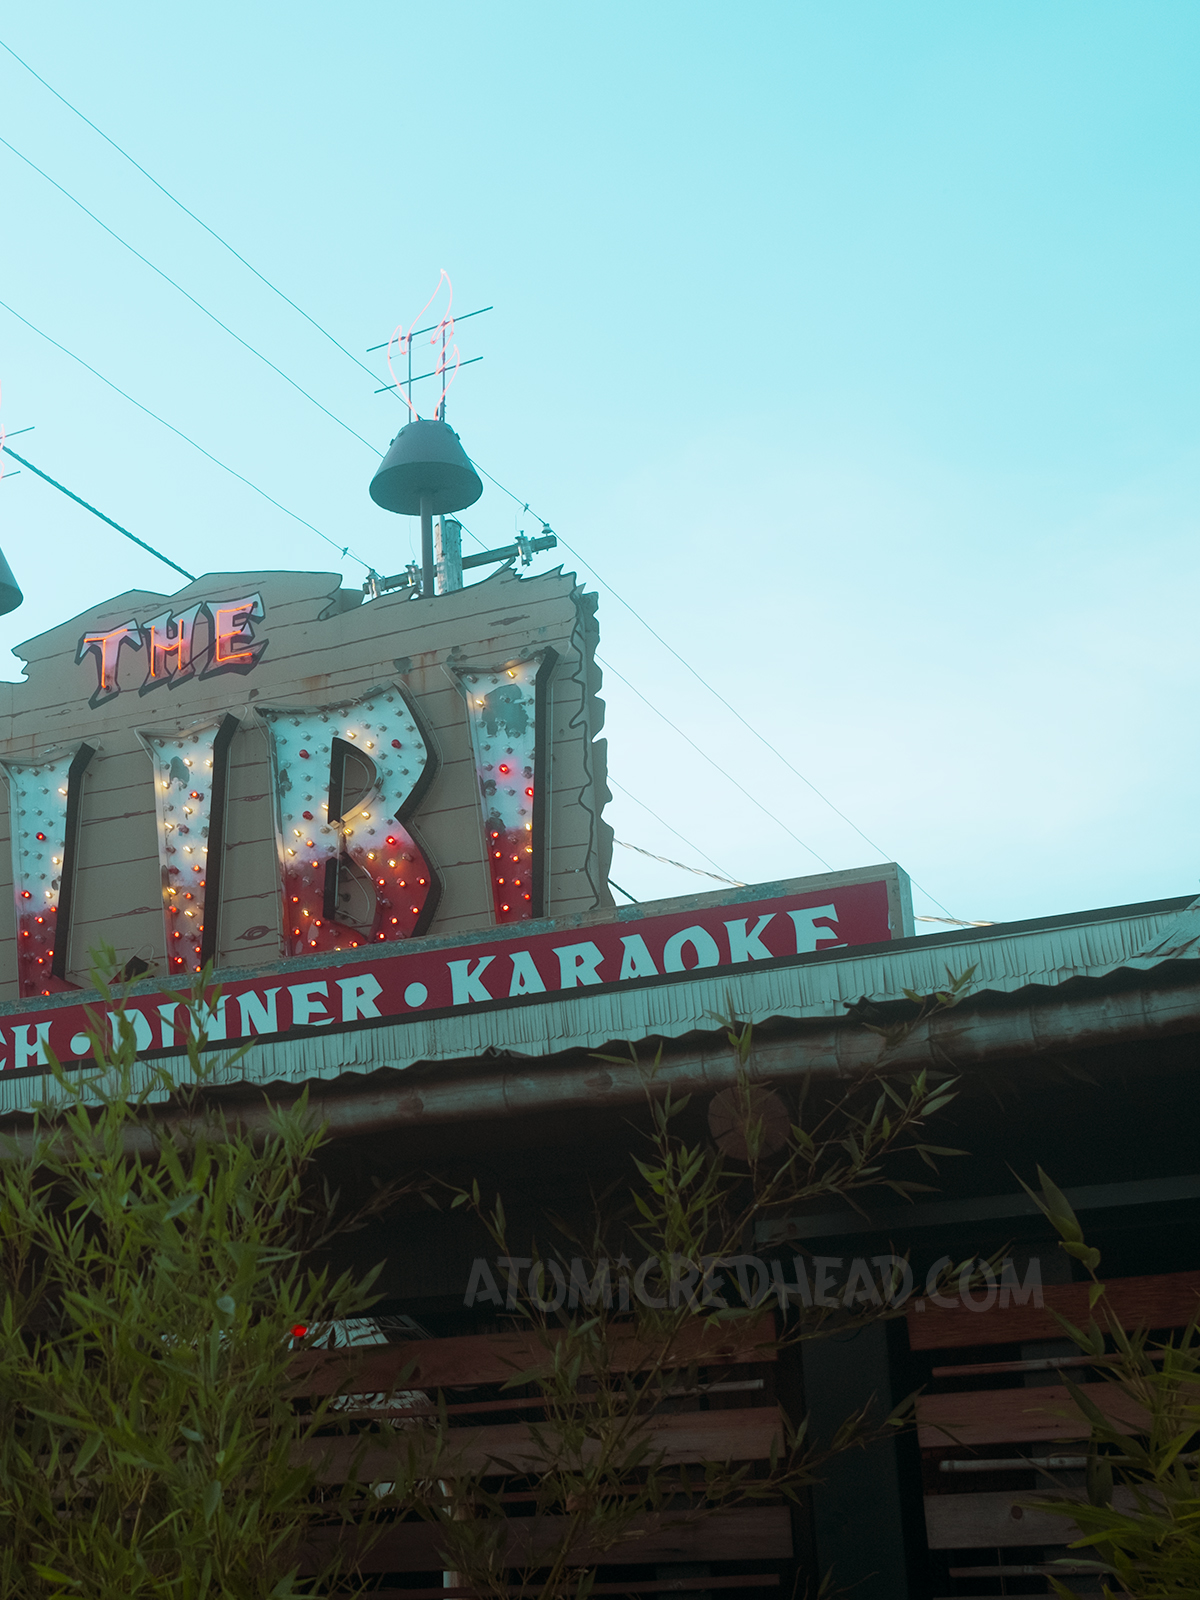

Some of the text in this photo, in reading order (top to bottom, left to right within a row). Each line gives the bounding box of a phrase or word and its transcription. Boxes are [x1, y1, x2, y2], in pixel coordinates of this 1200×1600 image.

[76, 591, 269, 706] THE
[107, 973, 384, 1056] DINNER
[446, 903, 849, 1005] KARAOKE
